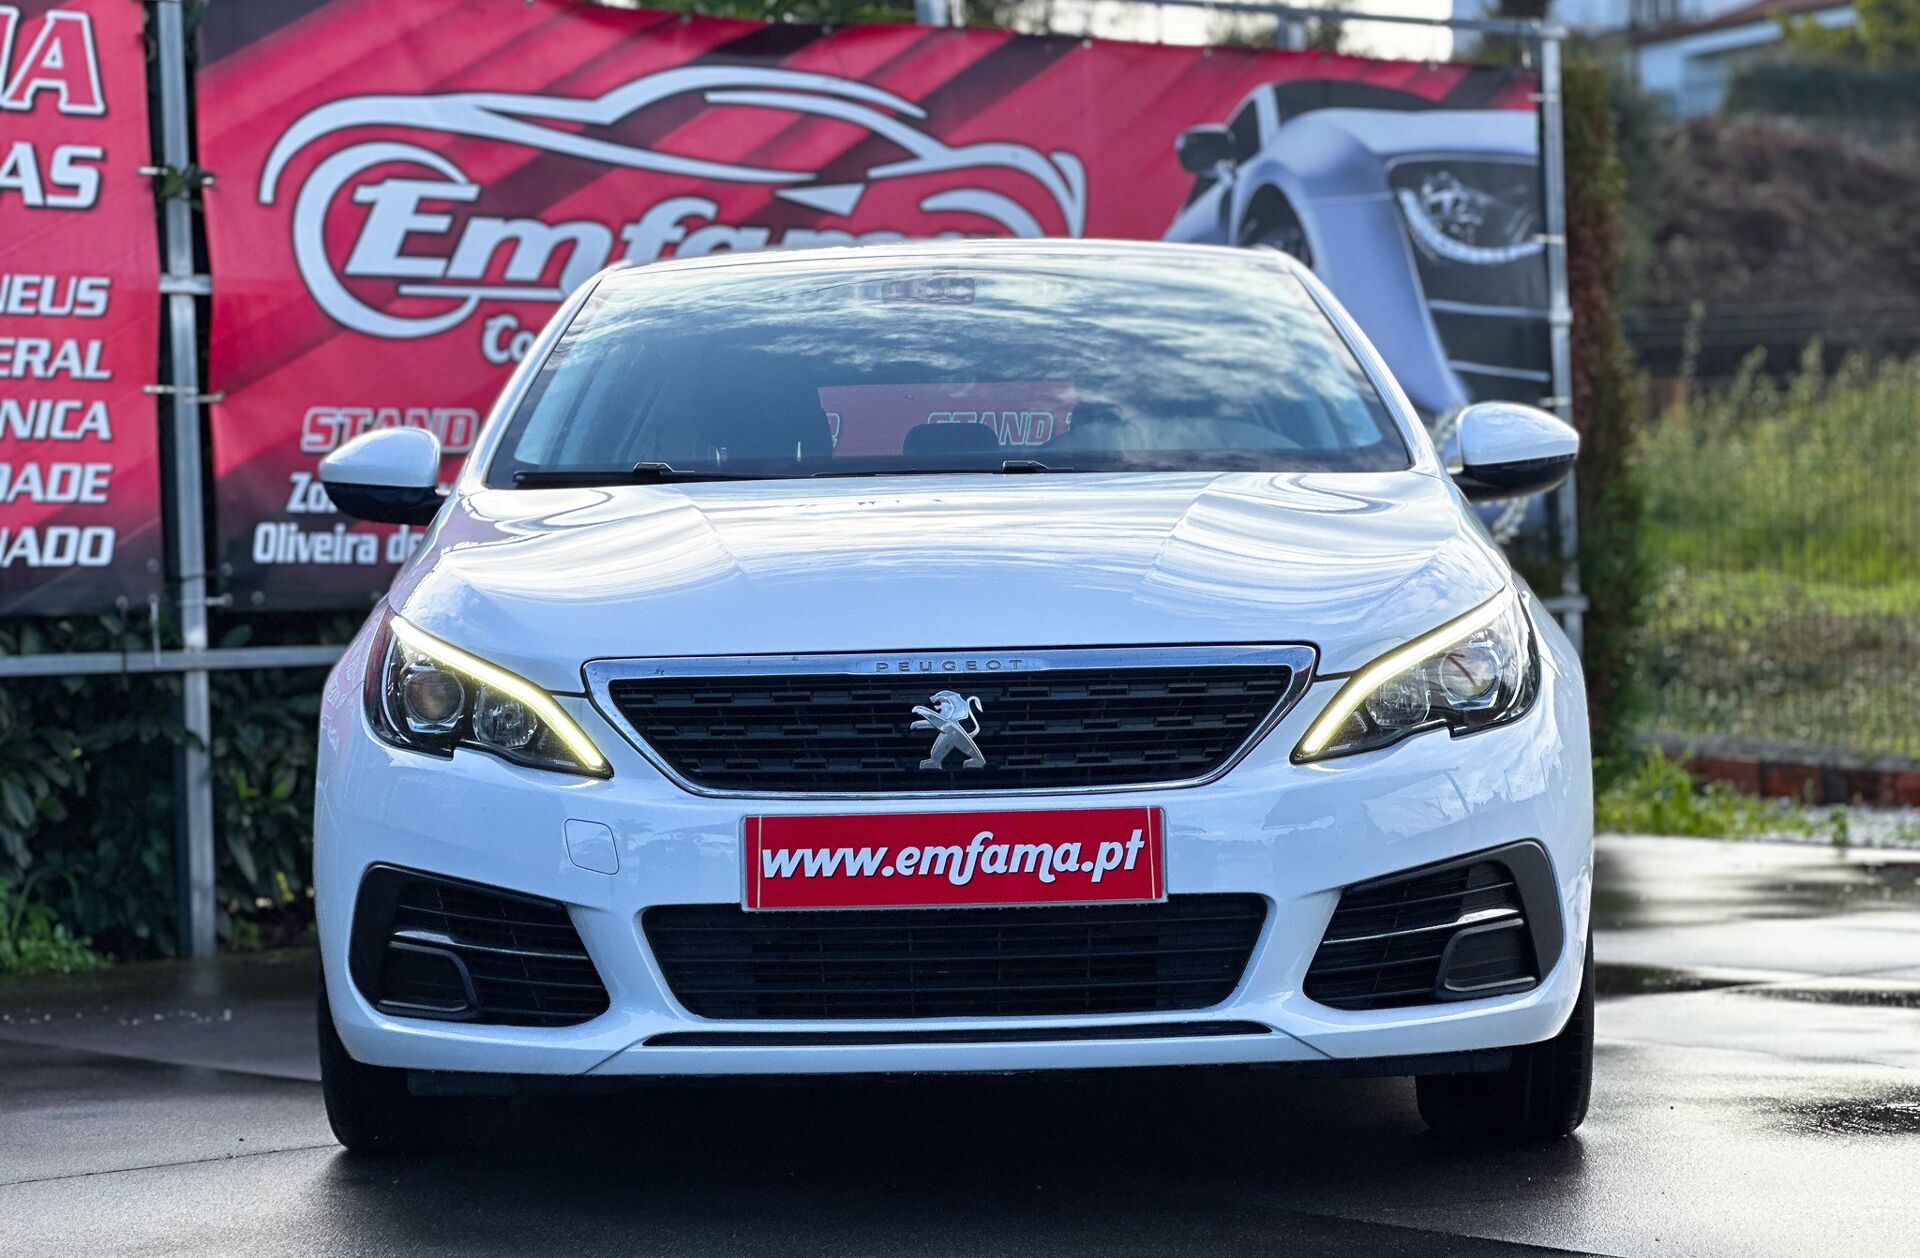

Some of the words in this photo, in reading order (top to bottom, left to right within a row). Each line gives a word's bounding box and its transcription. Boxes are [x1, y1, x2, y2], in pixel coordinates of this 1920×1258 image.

[0, 5, 106, 116] A
[0, 273, 112, 317] EUS
[286, 472, 338, 514] Zo
[0, 525, 117, 567] ADO
[252, 522, 380, 565] Oliveira
[875, 659, 1024, 673] PEUGEOT
[761, 828, 1145, 886] www.emfama.pt
